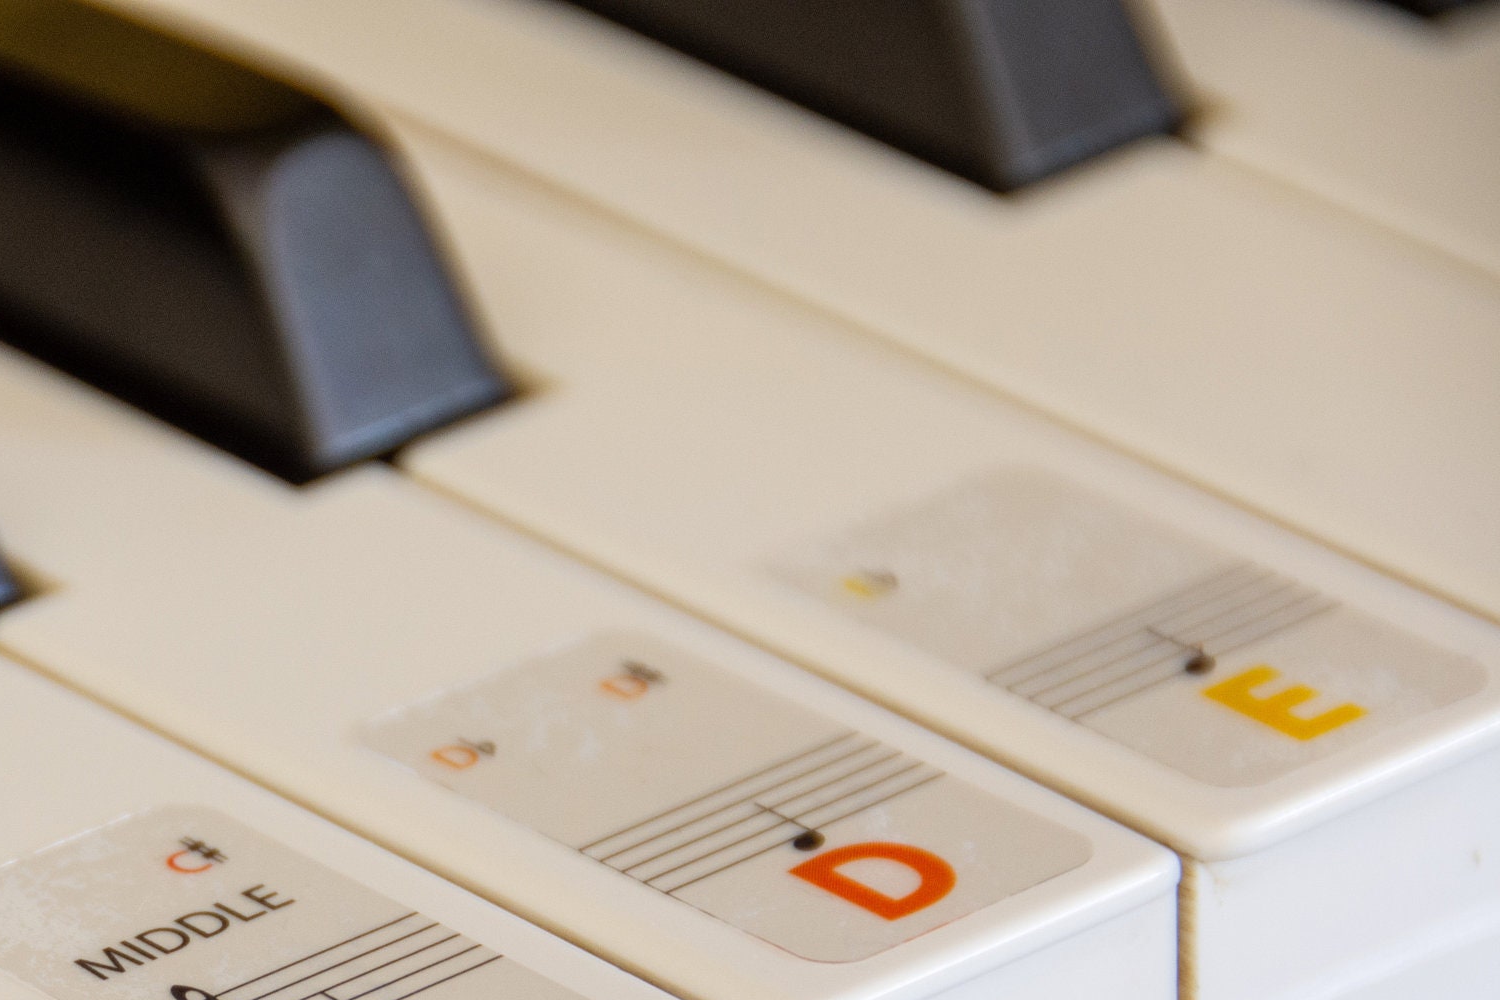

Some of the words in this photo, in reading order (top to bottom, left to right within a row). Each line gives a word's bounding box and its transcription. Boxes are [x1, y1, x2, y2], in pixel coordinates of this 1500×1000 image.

[1201, 664, 1370, 742] E
[165, 836, 228, 874] C#
[788, 840, 957, 922] D
[74, 884, 296, 981] MIDDLE
